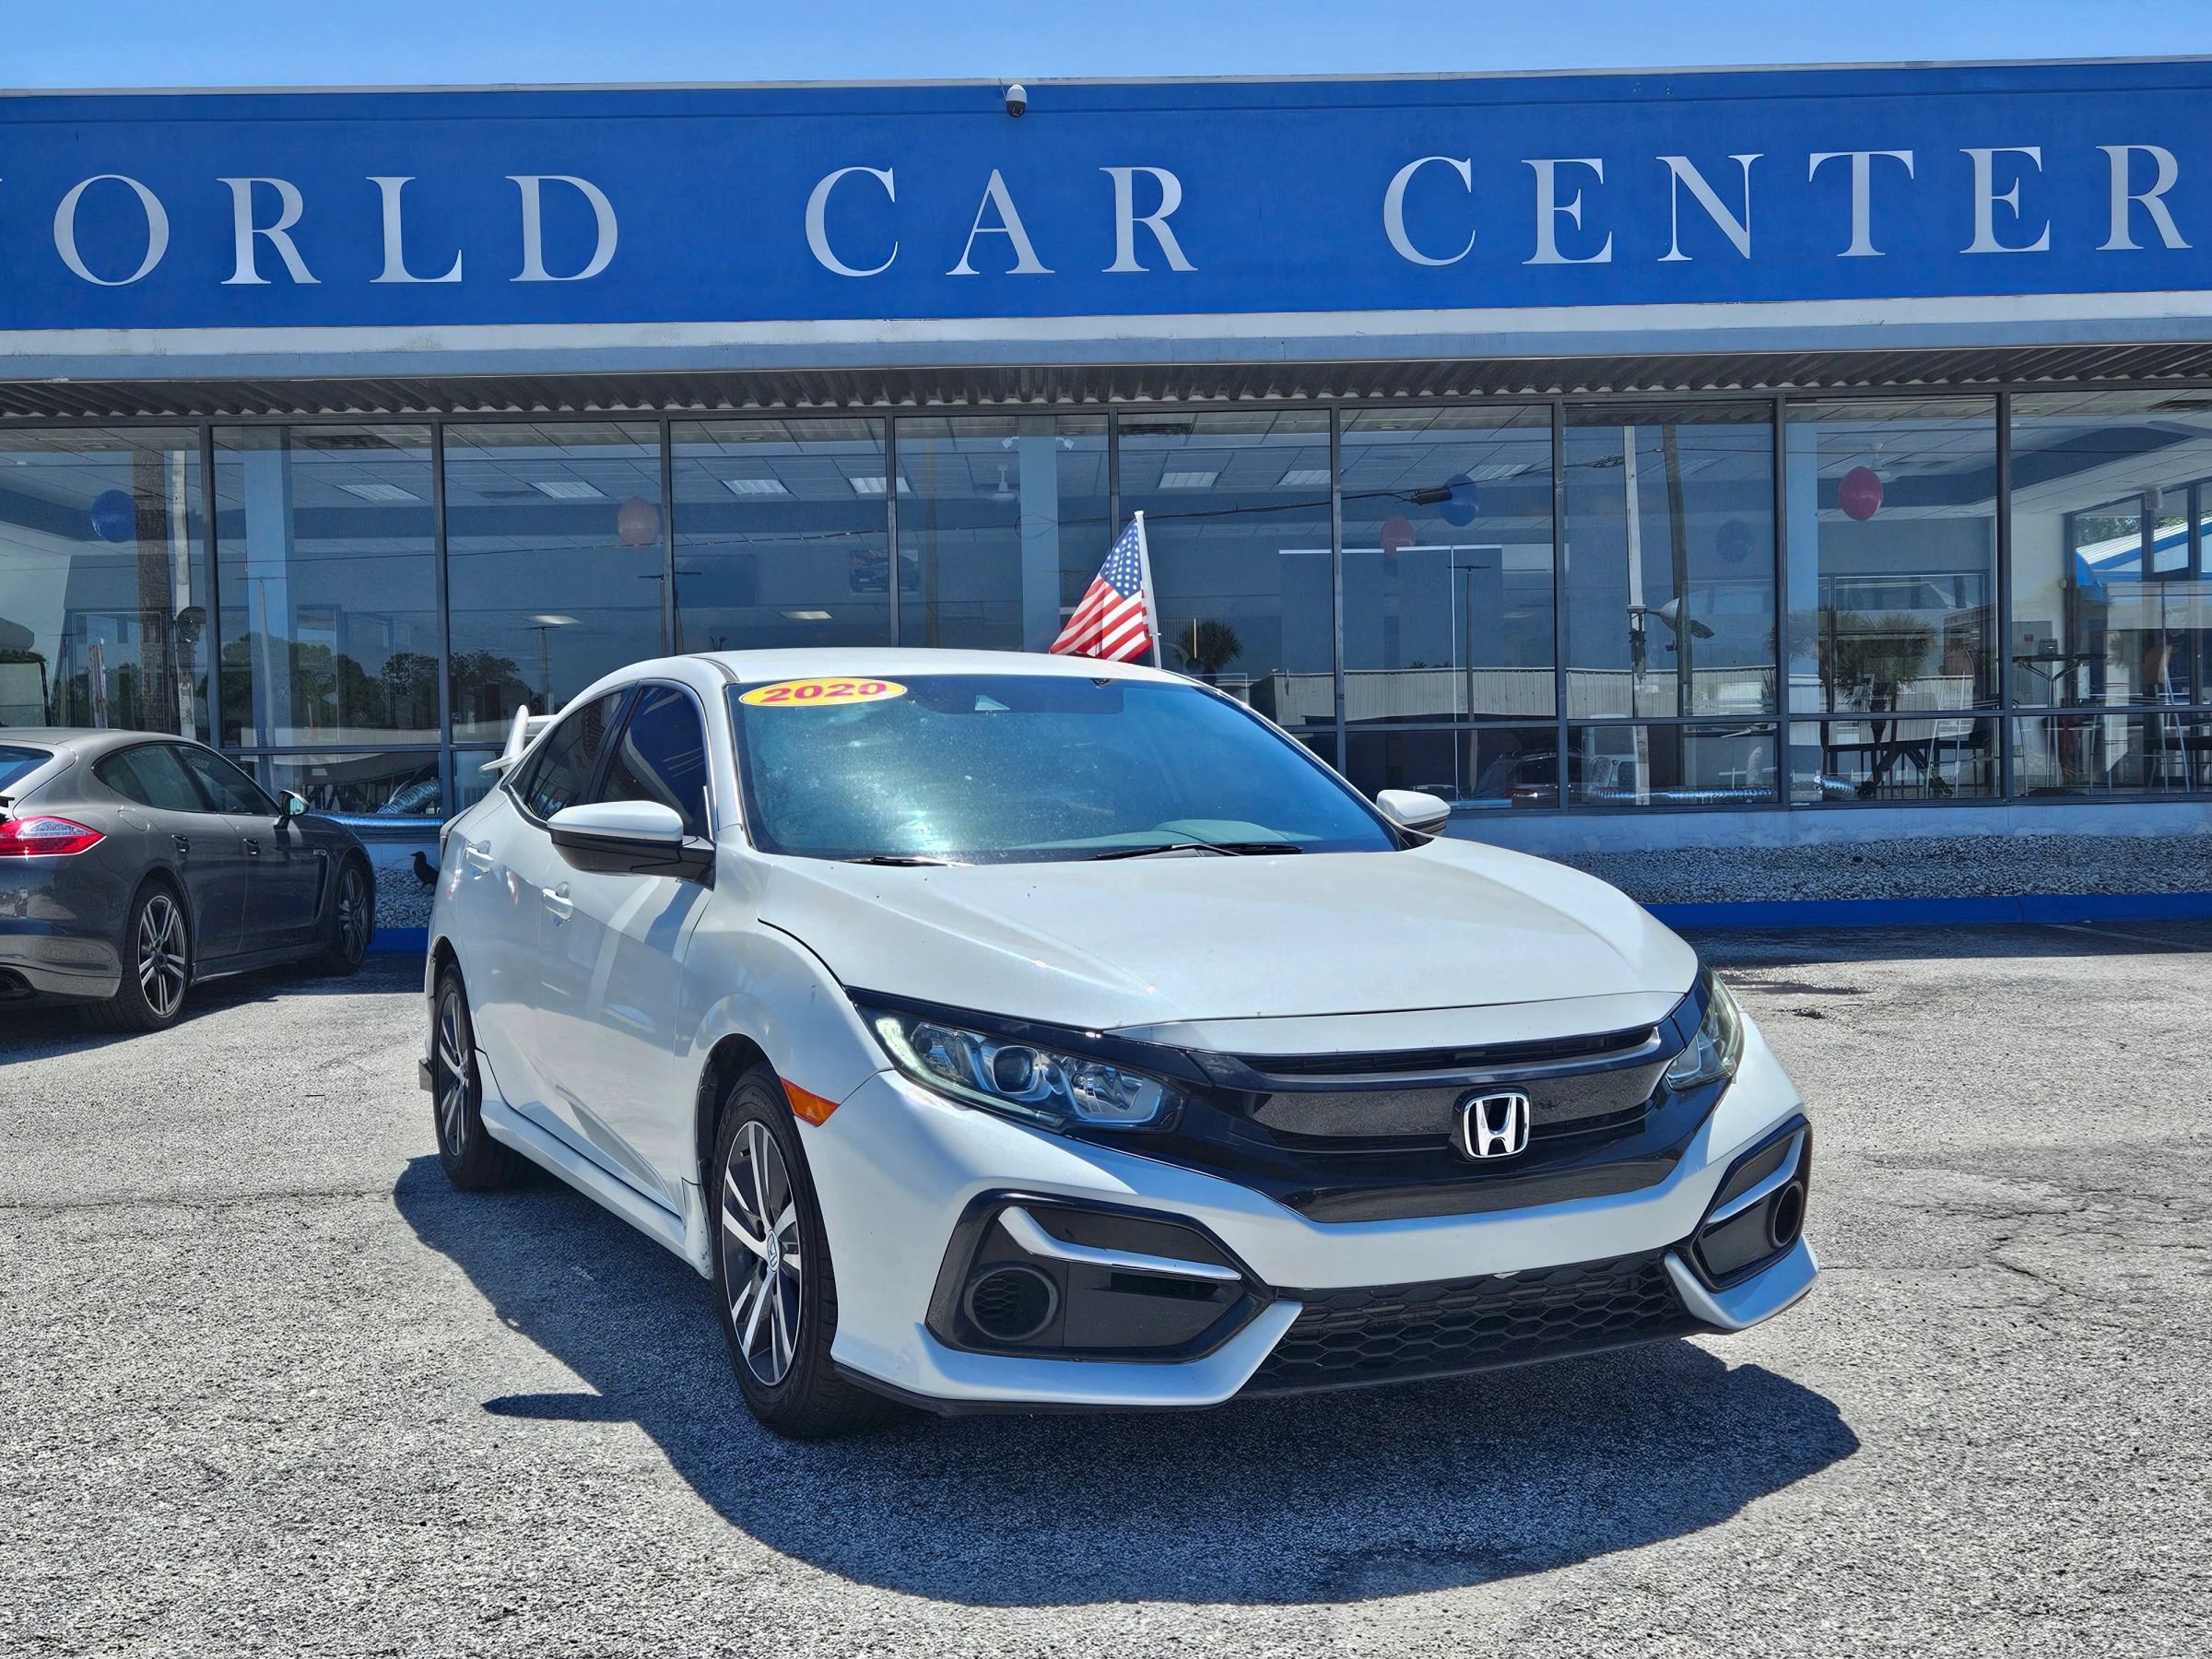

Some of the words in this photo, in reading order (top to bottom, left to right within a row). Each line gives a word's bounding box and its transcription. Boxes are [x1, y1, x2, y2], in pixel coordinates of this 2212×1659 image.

[0, 173, 619, 287] ORLD
[805, 166, 1198, 277] CAR
[1383, 145, 2193, 267] CENTER
[759, 682, 887, 703] 2020
